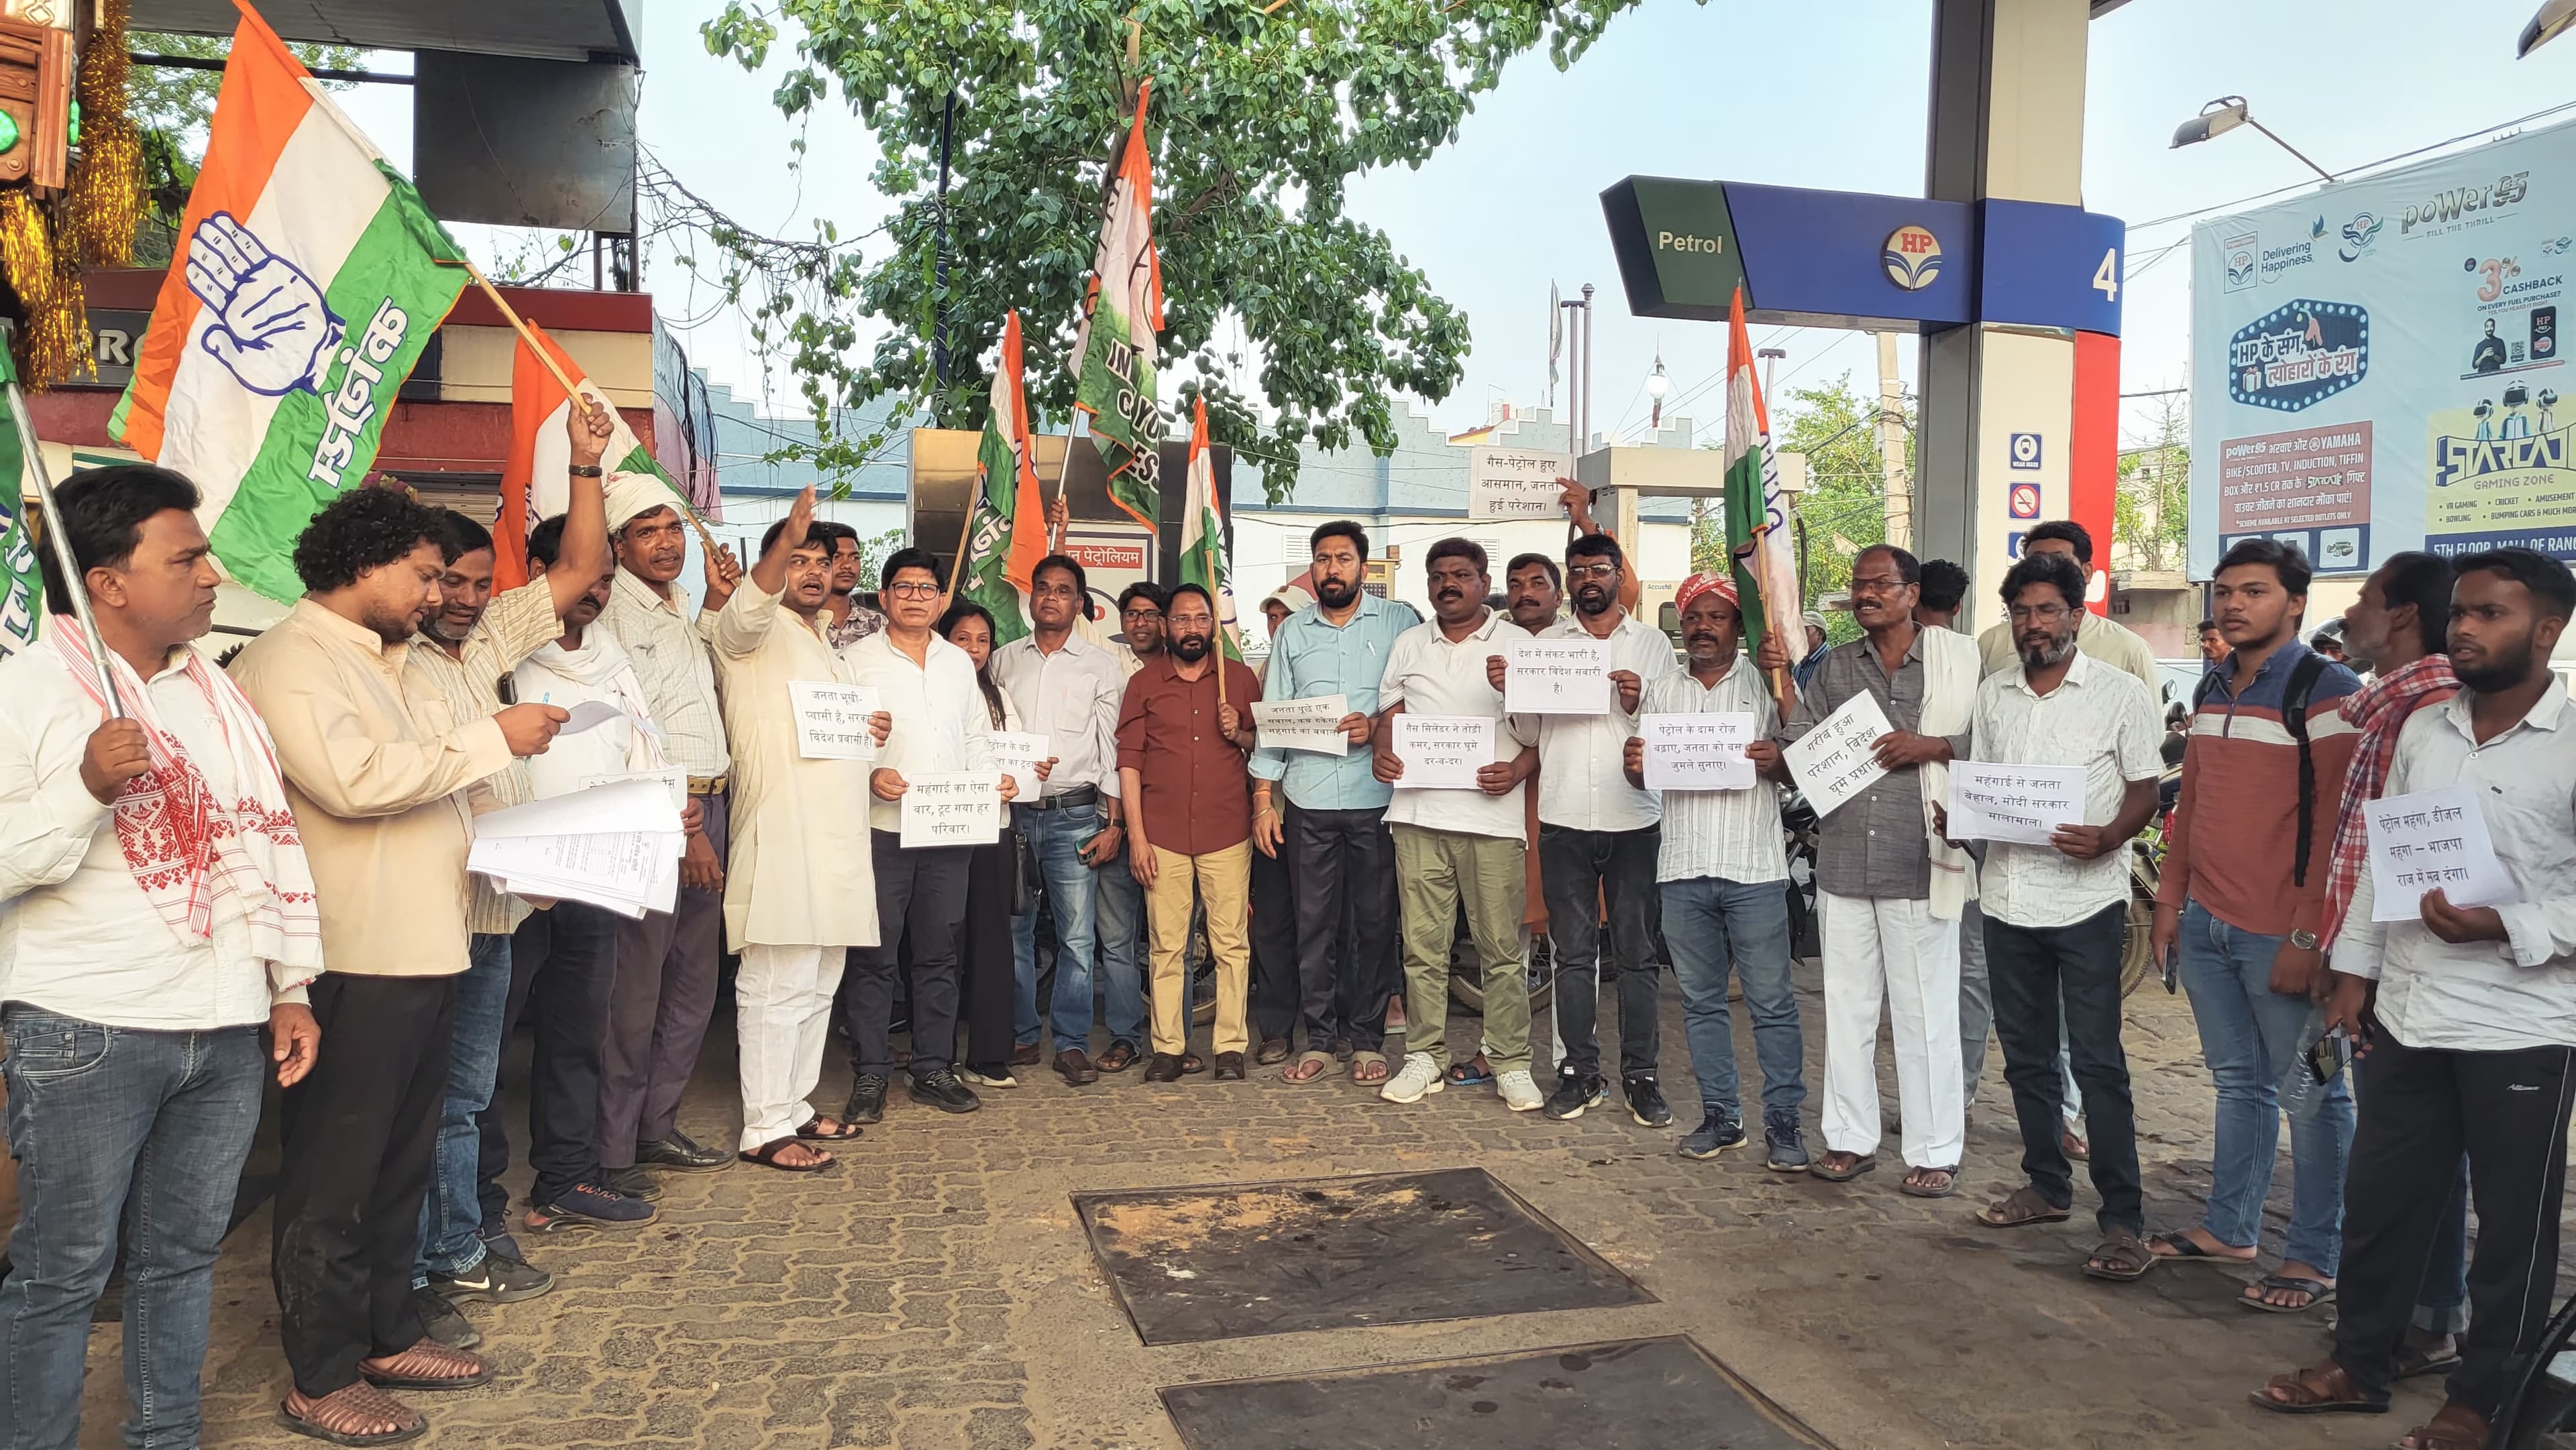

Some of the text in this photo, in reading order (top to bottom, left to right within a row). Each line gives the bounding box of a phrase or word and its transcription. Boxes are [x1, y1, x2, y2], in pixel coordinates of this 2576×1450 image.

[2356, 219, 2369, 229] HP
[2465, 217, 2494, 229] THRILL
[1658, 231, 1722, 254] Petrol
[1900, 233, 1933, 253] HP
[2263, 242, 2311, 261] Delivering
[2234, 256, 2248, 267] HP
[2261, 254, 2312, 273] Happiness
[2092, 247, 2117, 302] 4
[2503, 275, 2563, 294] CASHBACK
[2487, 301, 2506, 310] EVERY
[2523, 290, 2561, 303] PURCHASE?
[2536, 316, 2551, 325] HP
[2240, 331, 2304, 363] HP के संग,
[2267, 348, 2357, 384] त्योहारों के रंग
[2294, 438, 2308, 451] और
[2321, 433, 2361, 449] YAMAHA
[1487, 455, 1557, 473] गैस-पेट्रोल हुए
[2226, 452, 2364, 479] BIKE/SCOOTER, TV, INDUCTION, TIFFIN
[1481, 479, 1560, 492] आसमान, जनता
[2224, 486, 2239, 496] BOX
[2240, 482, 2254, 494] और
[2255, 482, 2269, 493] ₹1.5
[2270, 481, 2280, 491] CR
[2282, 480, 2294, 490] तक
[2294, 476, 2302, 489] के
[2474, 474, 2555, 490] GAMING ZONE
[2276, 498, 2286, 508] का
[2287, 496, 2314, 508] शानदार
[2316, 492, 2335, 505] मौका
[2455, 500, 2477, 509] GAMING
[2495, 497, 2519, 506] CRICKET
[2536, 492, 2575, 503] AMUSEMENT
[1489, 498, 1546, 513] हुई परेशान।
[2258, 515, 2284, 526] AVAILABLE
[2290, 514, 2314, 522] SELECTED
[2314, 512, 2336, 521] OUTLETS
[2337, 511, 2351, 520] ONLY
[2446, 514, 2471, 523] BOWLING
[2491, 510, 2518, 520] BUMPING
[2520, 508, 2535, 518] CARS
[2542, 507, 2561, 516] MUCH
[1083, 547, 1140, 566] पेट्रोलियम
[1518, 648, 1532, 659] देश
[1545, 648, 1566, 659] संकट
[1568, 649, 1588, 659] भारी
[1591, 649, 1600, 661] है,
[1517, 667, 1546, 676] सरकार
[1549, 665, 1571, 676] विदेश
[1552, 682, 1563, 694] है।
[811, 691, 837, 701] जनता
[847, 713, 873, 724] सरका
[1406, 722, 1418, 733] गैस
[1421, 722, 1450, 733] सिलेंडर
[1452, 723, 1459, 733] ने
[1659, 723, 1683, 736] पेट्रोल
[1686, 723, 1695, 734] के
[1698, 725, 1716, 734] दाम
[1807, 713, 1854, 752] गरीब हुआ
[809, 730, 835, 744] विदेश
[1009, 740, 1016, 751] के
[1409, 740, 1431, 750] कमर,
[1433, 741, 1462, 750] सरकार
[1683, 744, 1709, 752] जनता
[1713, 741, 1724, 752] को
[1807, 726, 1878, 779] परेशान, विदेश
[1671, 759, 1695, 772] जुमले
[916, 780, 990, 796] महंगाई का ऐसा
[1975, 775, 2062, 790] महंगाई से जनता
[938, 804, 951, 817] टूट
[955, 804, 973, 813] गया
[977, 803, 990, 816] हर
[2002, 795, 2028, 808] मोदी
[2032, 799, 2070, 810] सरकार
[1988, 812, 2043, 828] मालामाल।
[2403, 811, 2430, 830] महंगा,
[2432, 805, 2463, 822] डीजल
[932, 822, 969, 835] परिवार।
[2390, 838, 2463, 861] महंगा भाजपा
[2396, 866, 2469, 887] राज में दंगा।
